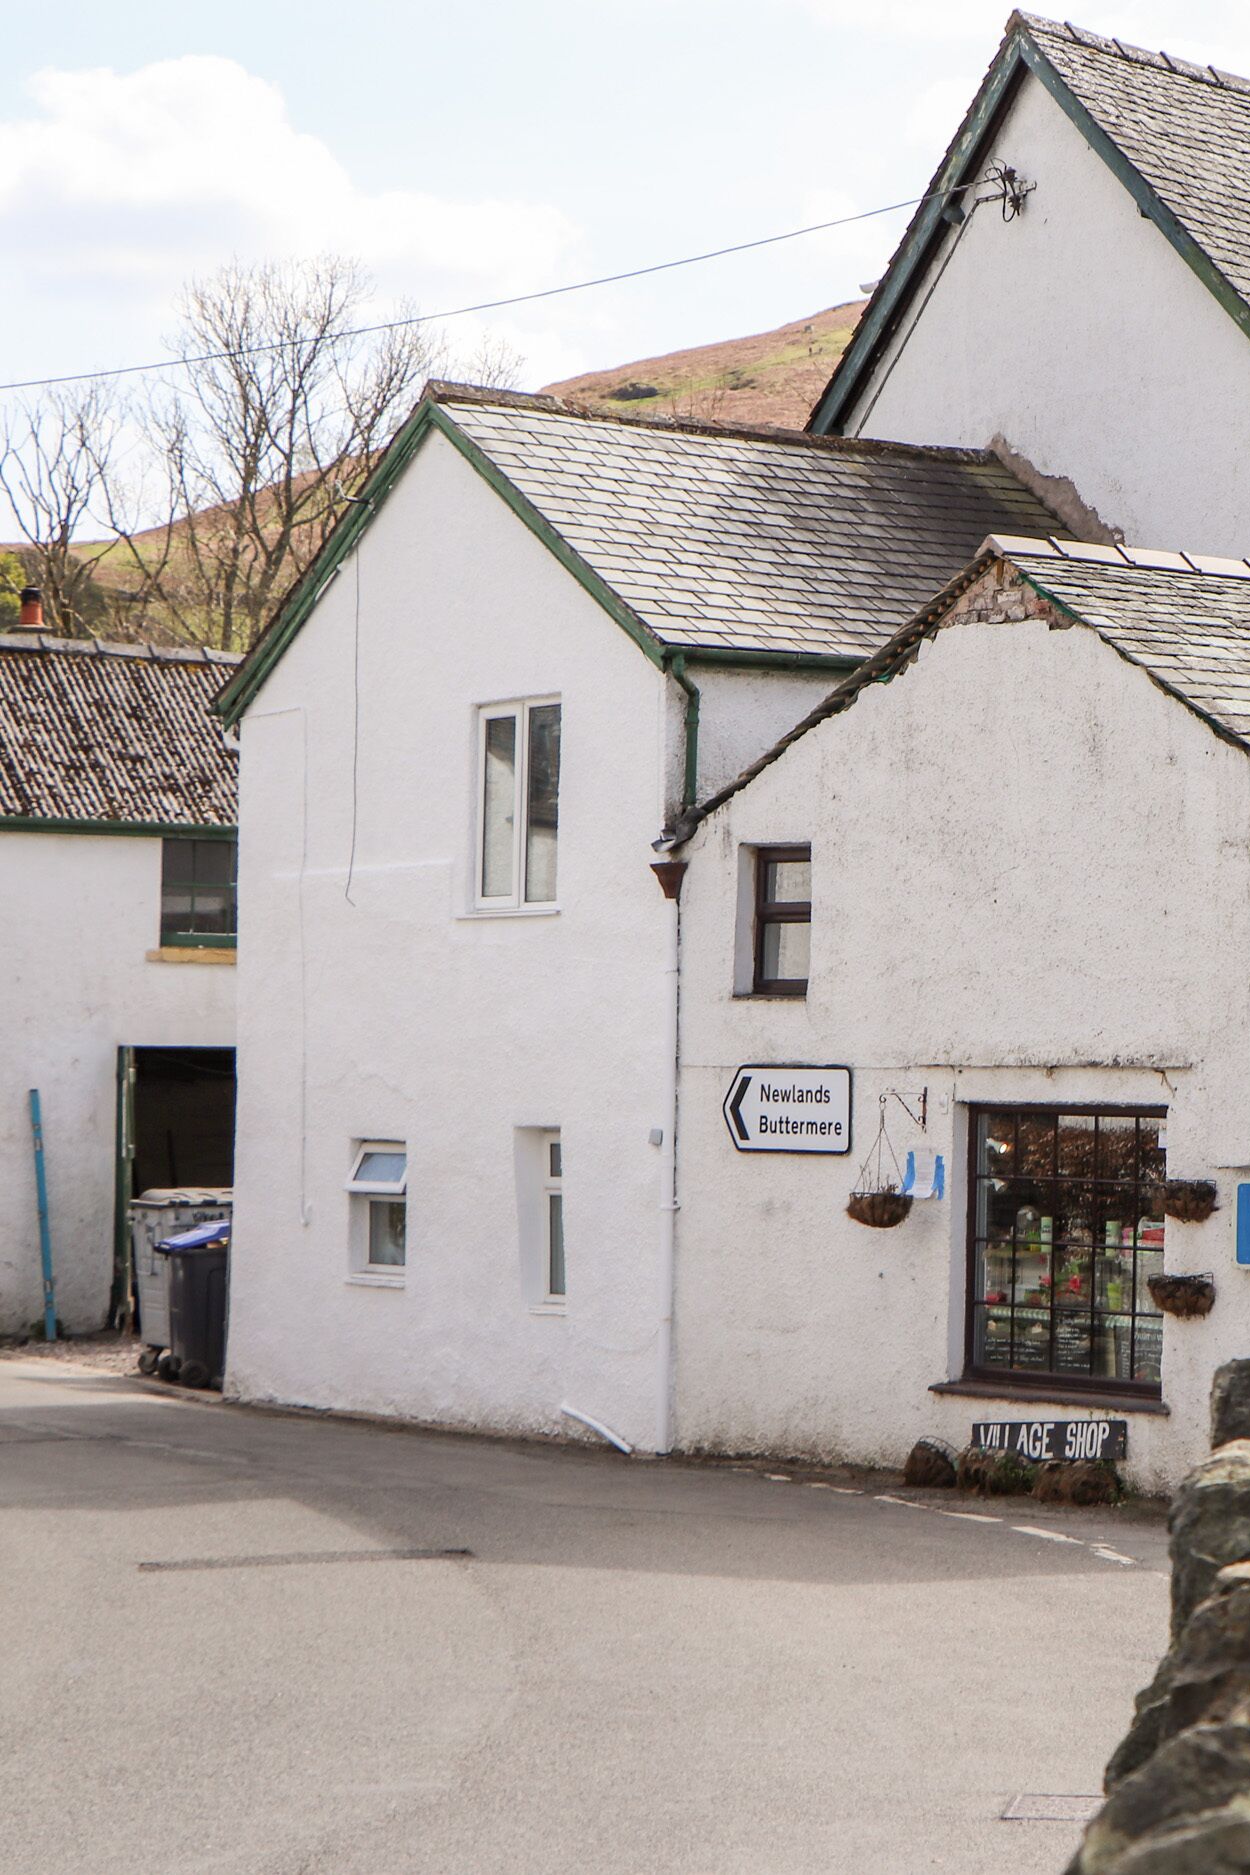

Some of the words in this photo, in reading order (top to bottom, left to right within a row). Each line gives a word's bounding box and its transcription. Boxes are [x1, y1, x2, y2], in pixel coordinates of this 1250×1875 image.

[759, 1084, 831, 1105] Newlands
[759, 1115, 843, 1136] Buttermere
[1064, 1421, 1110, 1459] SHOP
